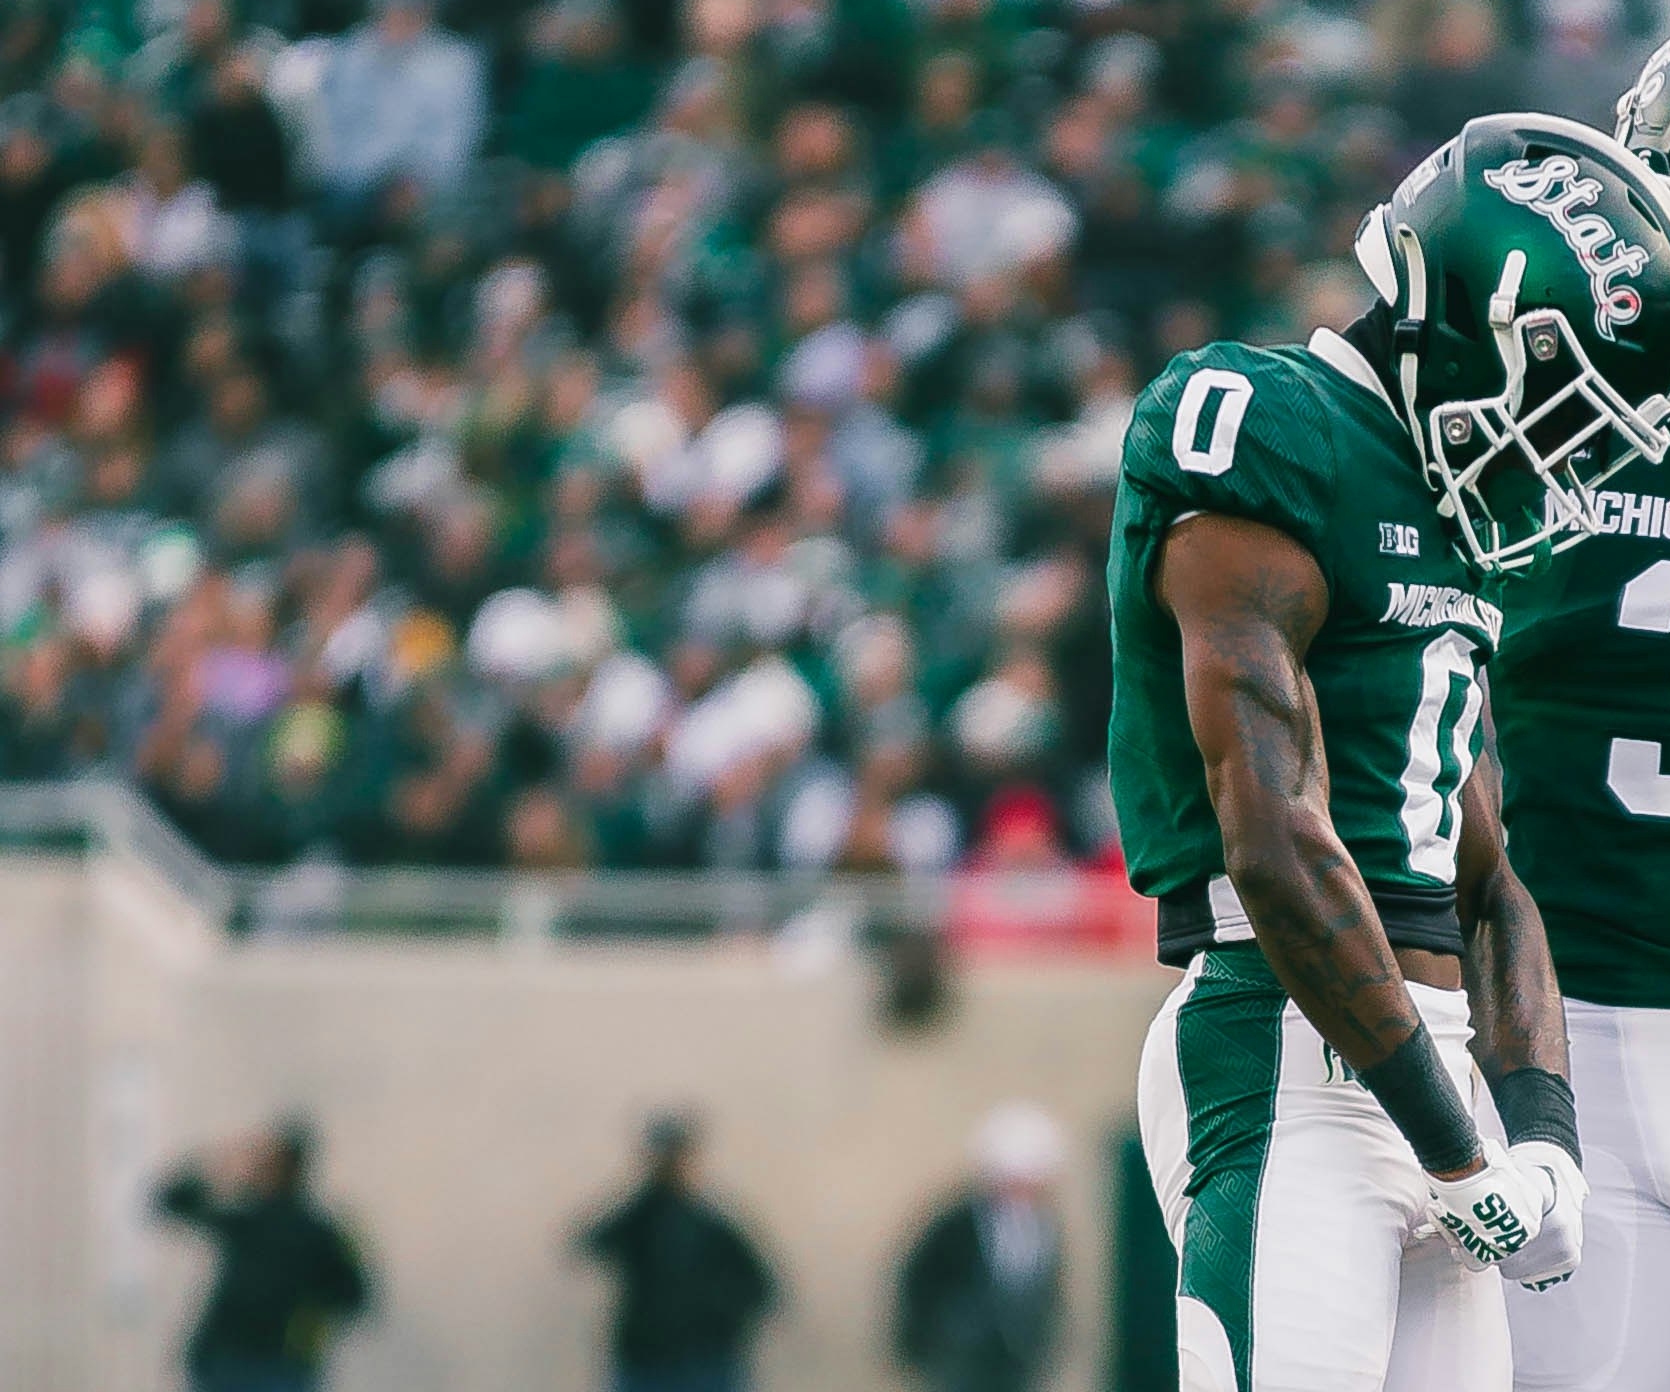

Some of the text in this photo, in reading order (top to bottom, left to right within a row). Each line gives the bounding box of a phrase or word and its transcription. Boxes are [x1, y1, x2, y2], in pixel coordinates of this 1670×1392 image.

[1484, 155, 1650, 343] State
[1172, 369, 1254, 478] 0
[1400, 628, 1483, 885] 0
